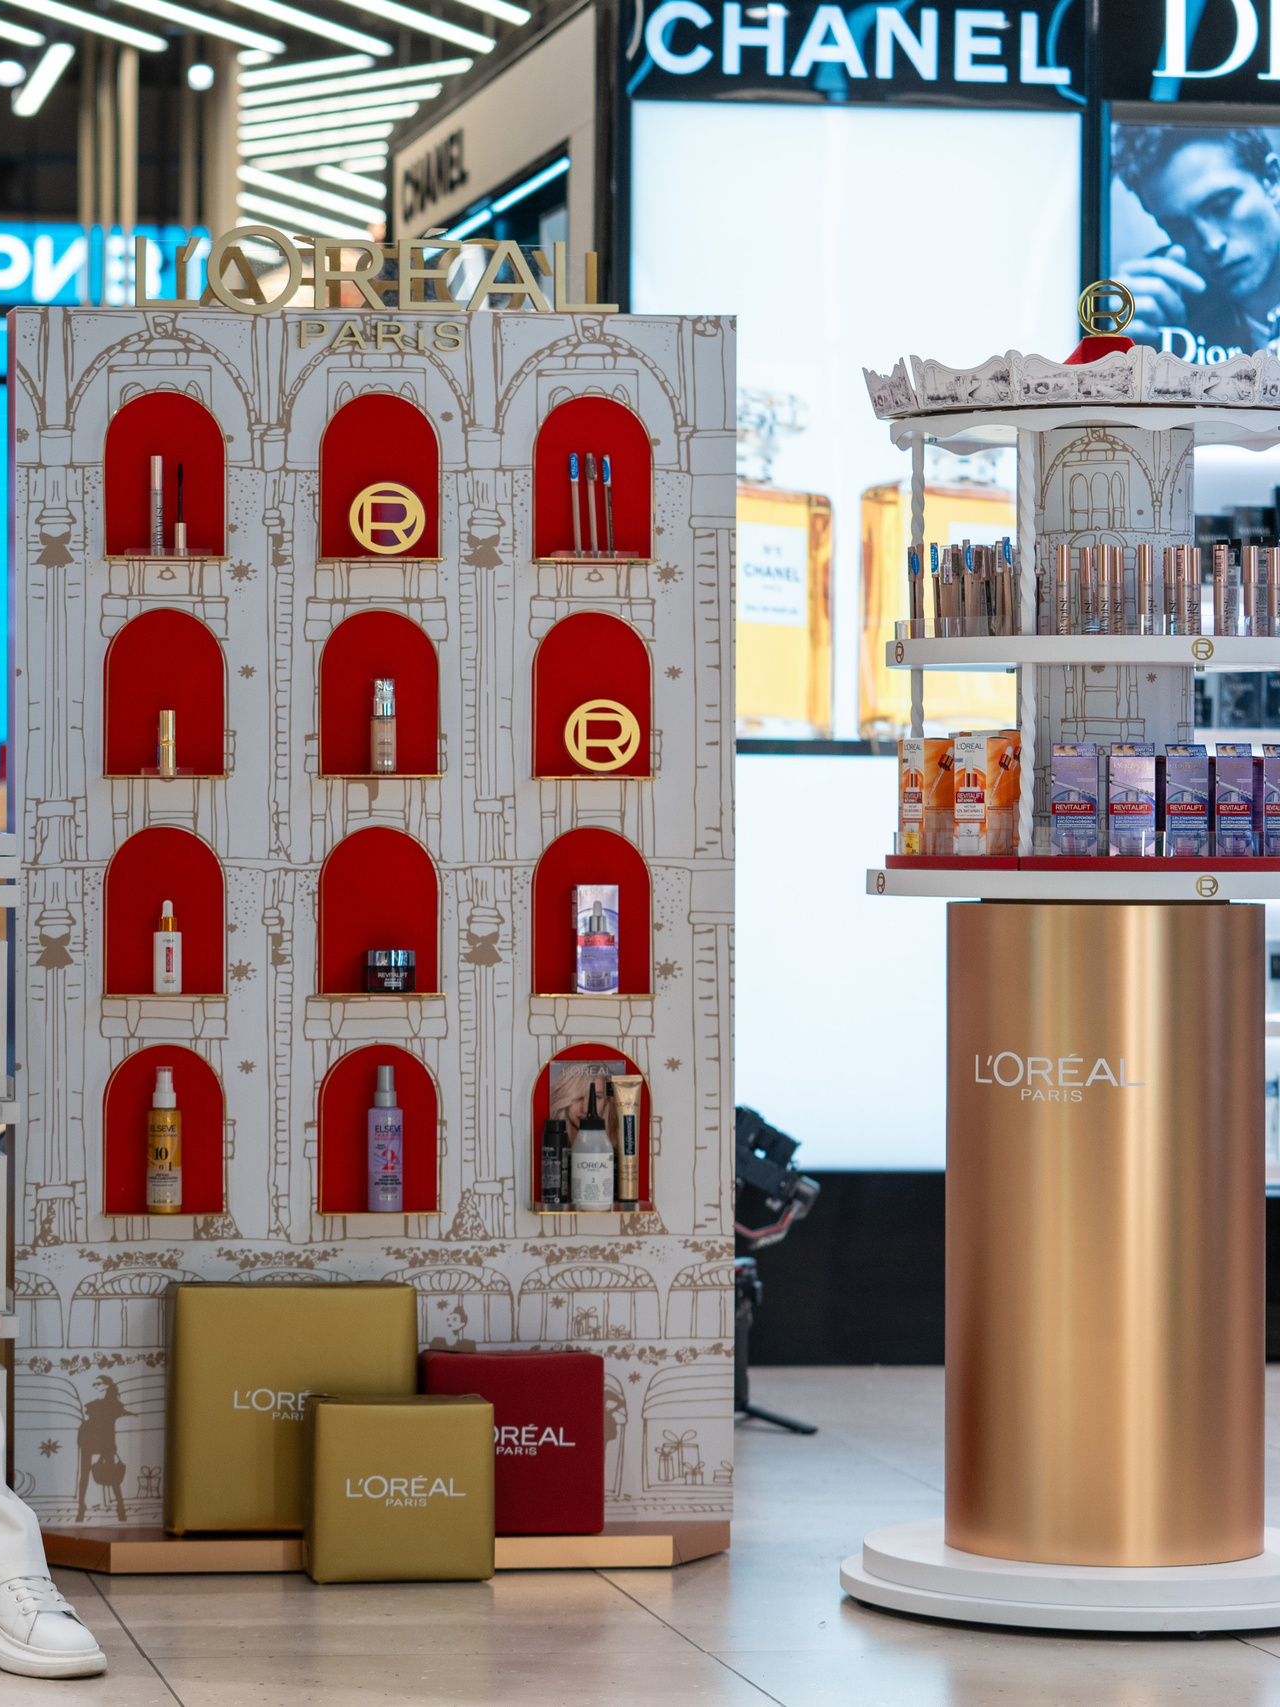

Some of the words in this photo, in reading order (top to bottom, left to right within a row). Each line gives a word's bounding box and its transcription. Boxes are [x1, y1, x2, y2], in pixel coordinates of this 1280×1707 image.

[645, 0, 1071, 85] CHANEL
[402, 127, 469, 223] CHANEL
[975, 1051, 1146, 1087] L'ORÉAL
[150, 1124, 176, 1133] ELSEVE
[155, 1147, 169, 1161] 10
[346, 1475, 467, 1499] L'ORÉAL
